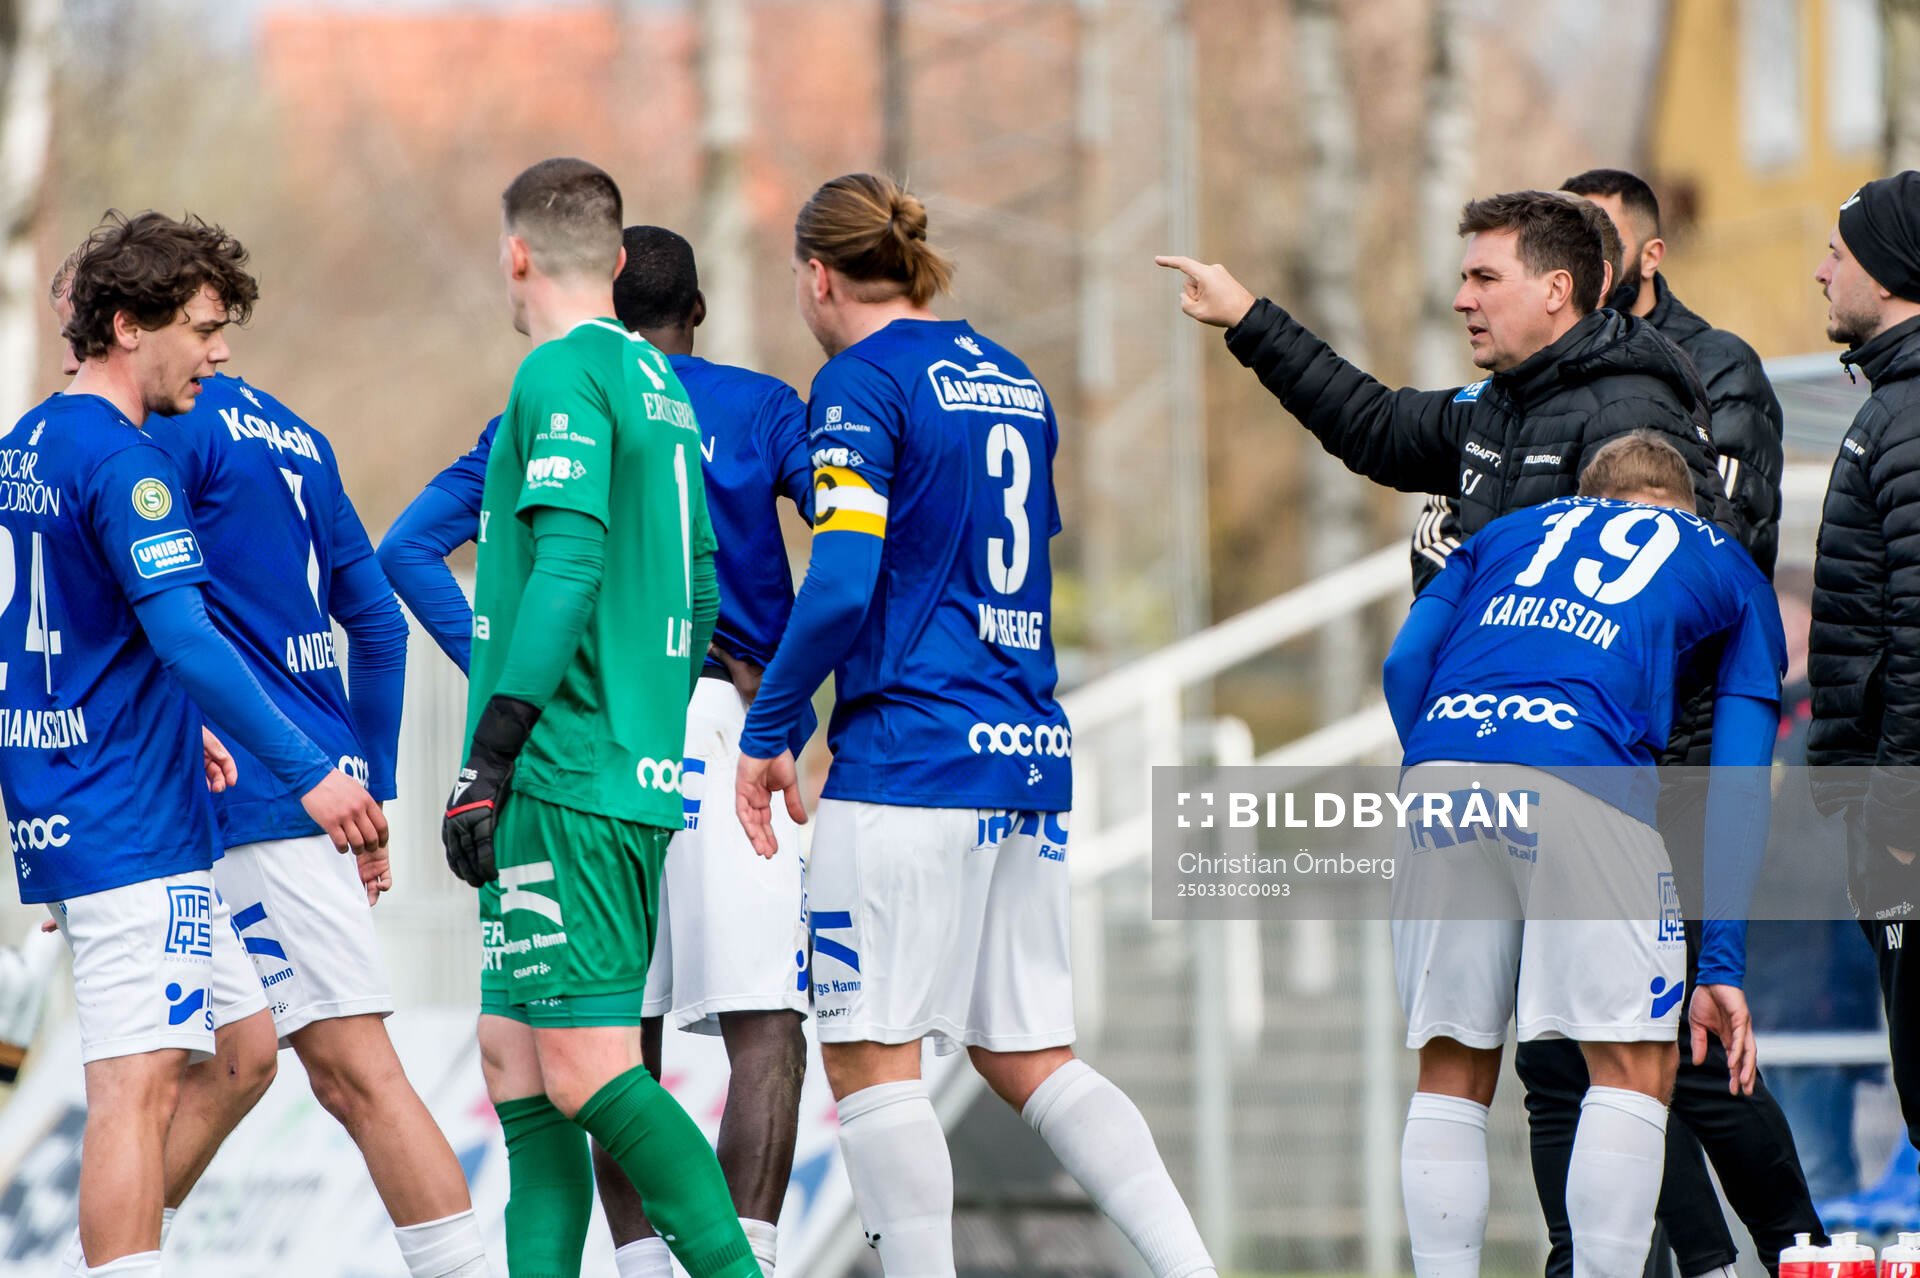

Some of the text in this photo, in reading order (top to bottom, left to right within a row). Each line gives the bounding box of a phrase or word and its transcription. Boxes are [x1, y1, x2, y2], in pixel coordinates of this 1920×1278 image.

[1465, 441, 1499, 463] CRAFT
[815, 473, 838, 527] C
[985, 423, 1031, 595] 3
[138, 536, 195, 563] UNIBET
[1514, 506, 1681, 605] 19
[977, 603, 1044, 651] WBERG
[1479, 593, 1622, 650] KARLSSON
[1875, 905, 1903, 920] CRAFT
[260, 966, 294, 989] Hamn
[816, 1007, 847, 1019] CRAFT
